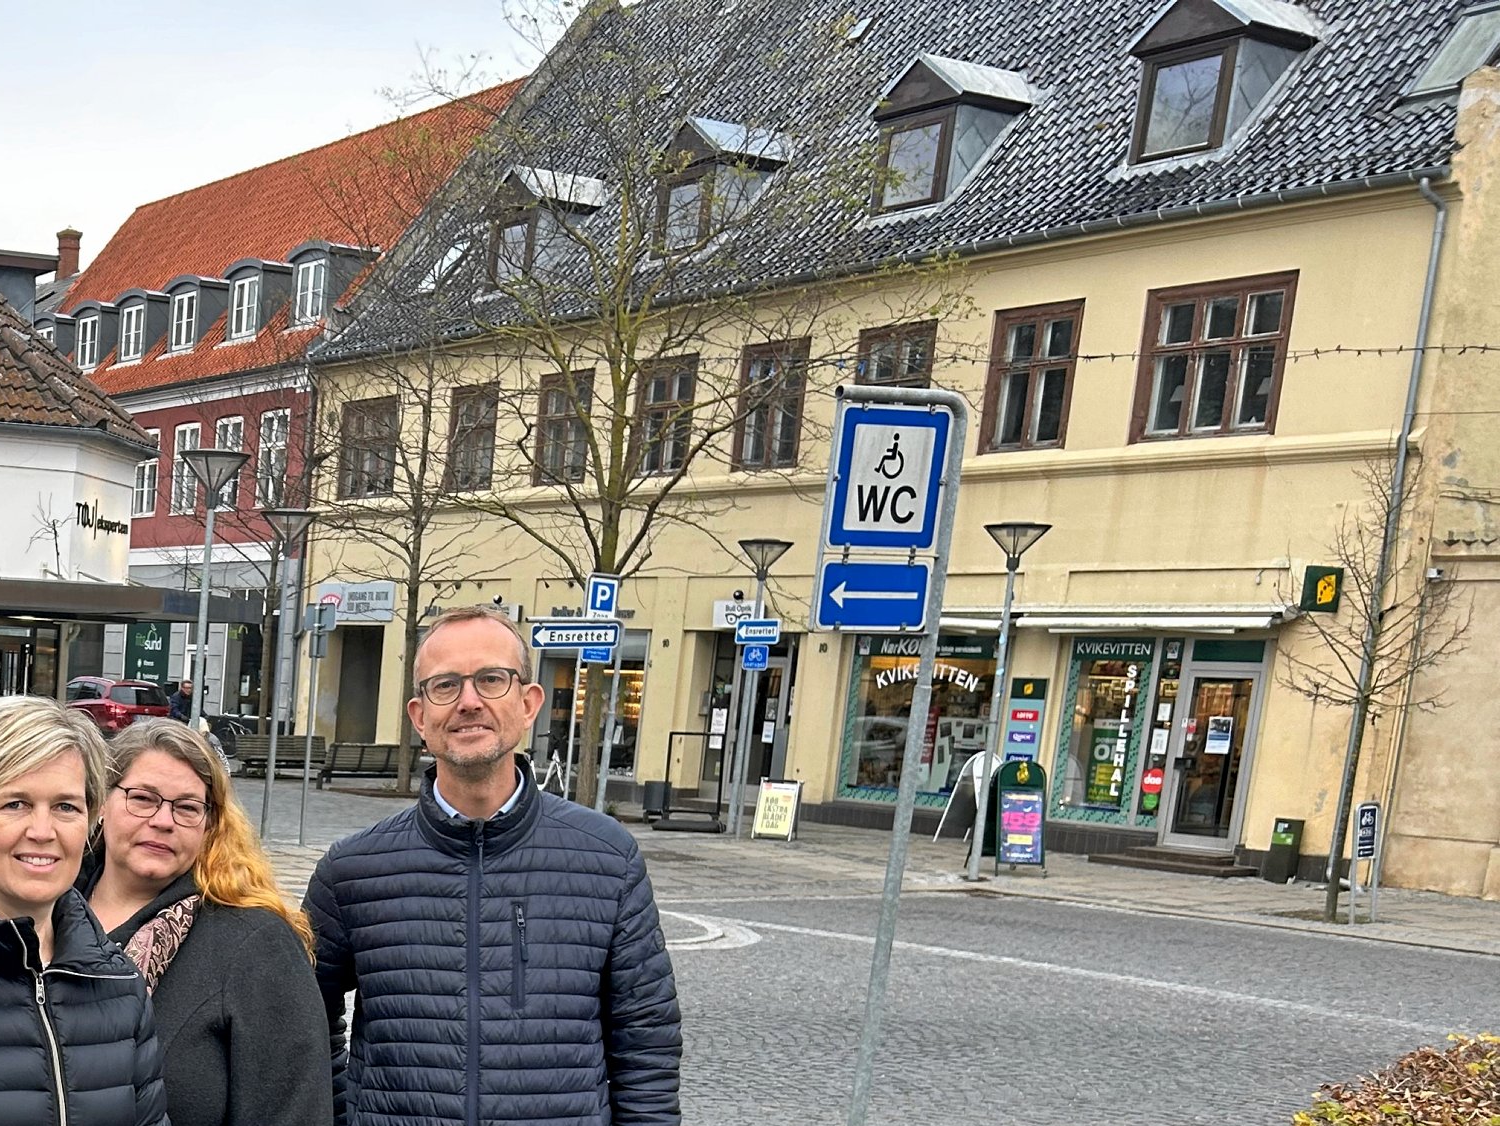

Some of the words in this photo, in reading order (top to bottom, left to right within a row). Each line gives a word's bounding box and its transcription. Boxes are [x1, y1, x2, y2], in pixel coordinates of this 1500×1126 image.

[857, 484, 917, 524] WC
[596, 585, 611, 608] P
[549, 631, 609, 642] Ensrettet
[880, 637, 924, 655] NærKØ
[1076, 642, 1150, 655] KVIKEVITTEN
[875, 663, 979, 693] KVIKEITTEN
[1109, 665, 1137, 796] SPILLEHAL
